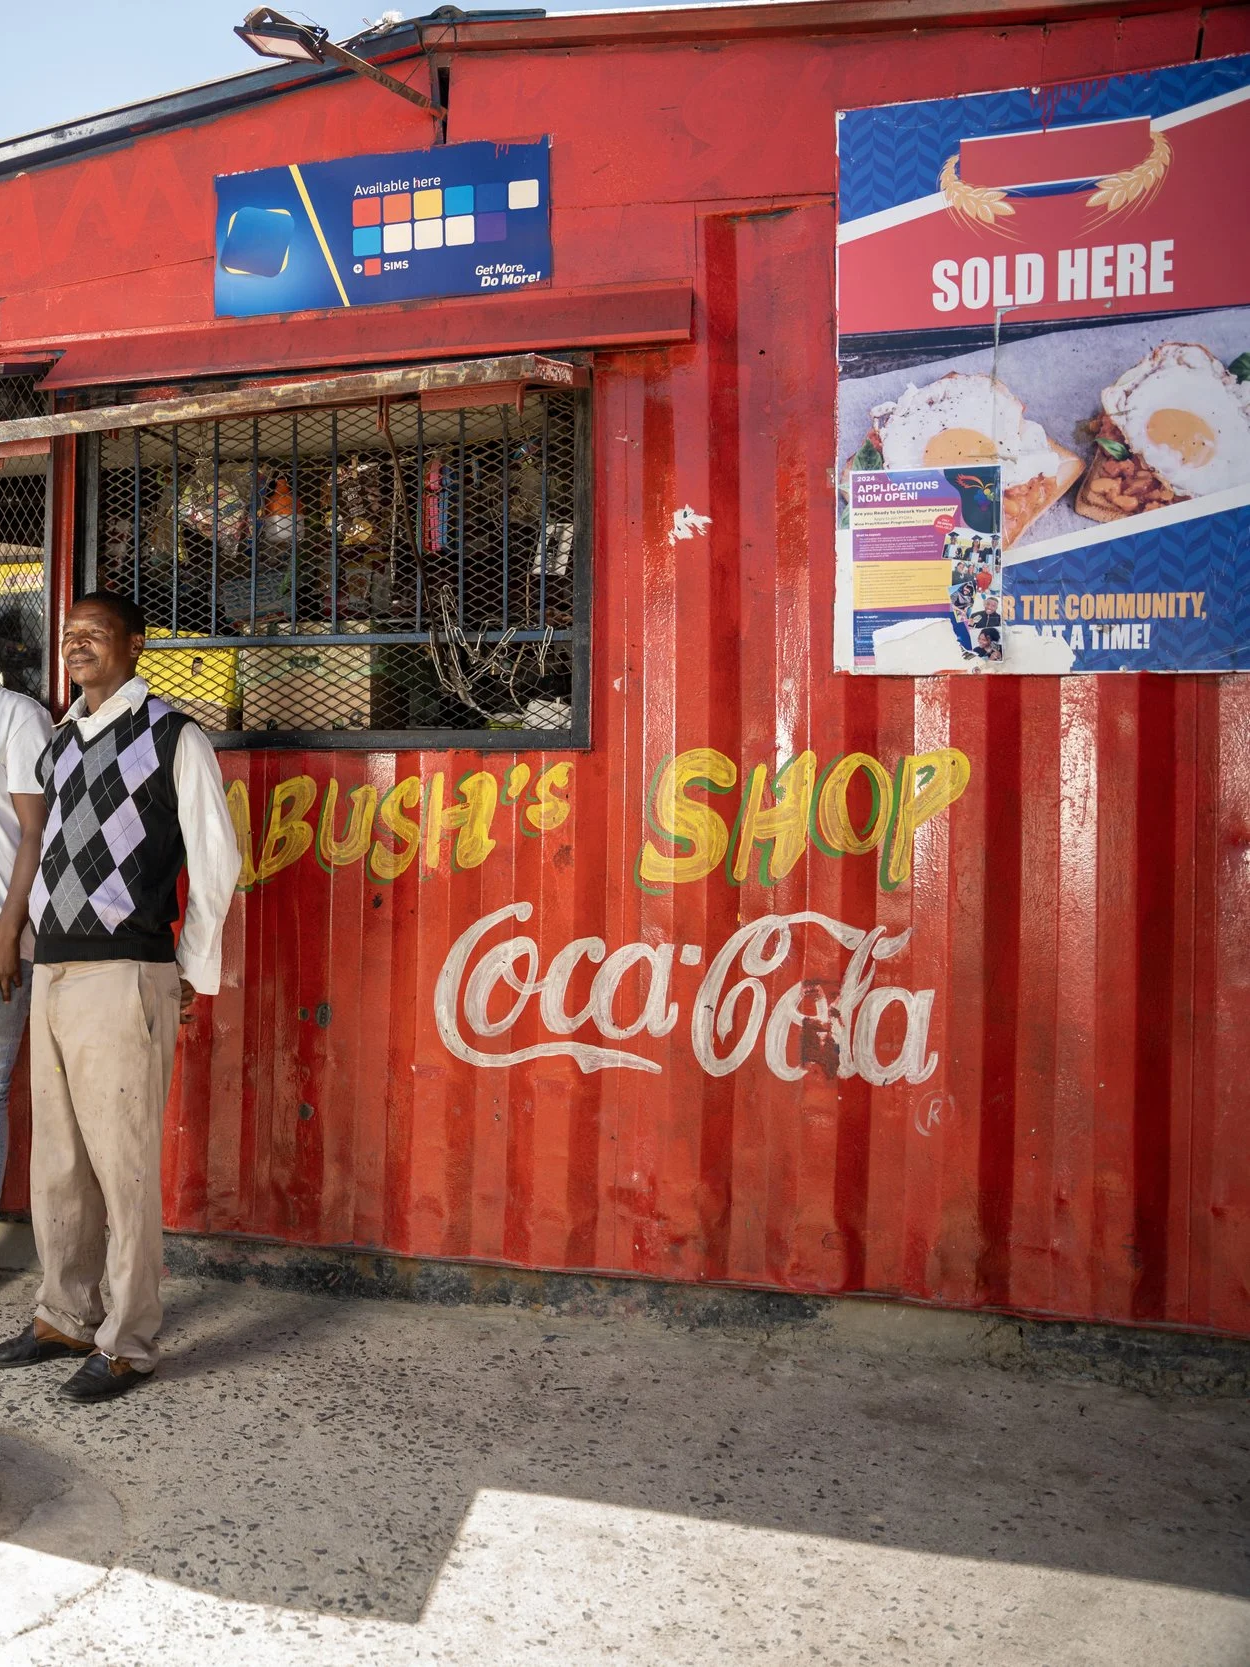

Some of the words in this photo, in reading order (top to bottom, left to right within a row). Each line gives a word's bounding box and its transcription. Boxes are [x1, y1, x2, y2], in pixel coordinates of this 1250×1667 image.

[353, 179, 410, 197] Available
[413, 176, 441, 189] here
[383, 260, 410, 271] SIMS
[475, 264, 495, 276] Get
[495, 262, 526, 274] More,
[932, 253, 1045, 312] SOLD
[1057, 239, 1174, 302] HERE
[480, 275, 499, 287] Do
[501, 270, 542, 286] More!
[857, 480, 939, 493] APPLICATIONS
[857, 493, 882, 503] NOW
[884, 491, 918, 502] OPEN!
[1020, 594, 1060, 620] THE
[1065, 591, 1207, 621] COMMUNITY,
[1070, 624, 1085, 650] A
[1088, 623, 1151, 650] TIME!
[636, 747, 972, 893] SHOP
[434, 901, 939, 1086] Coca-Cola
